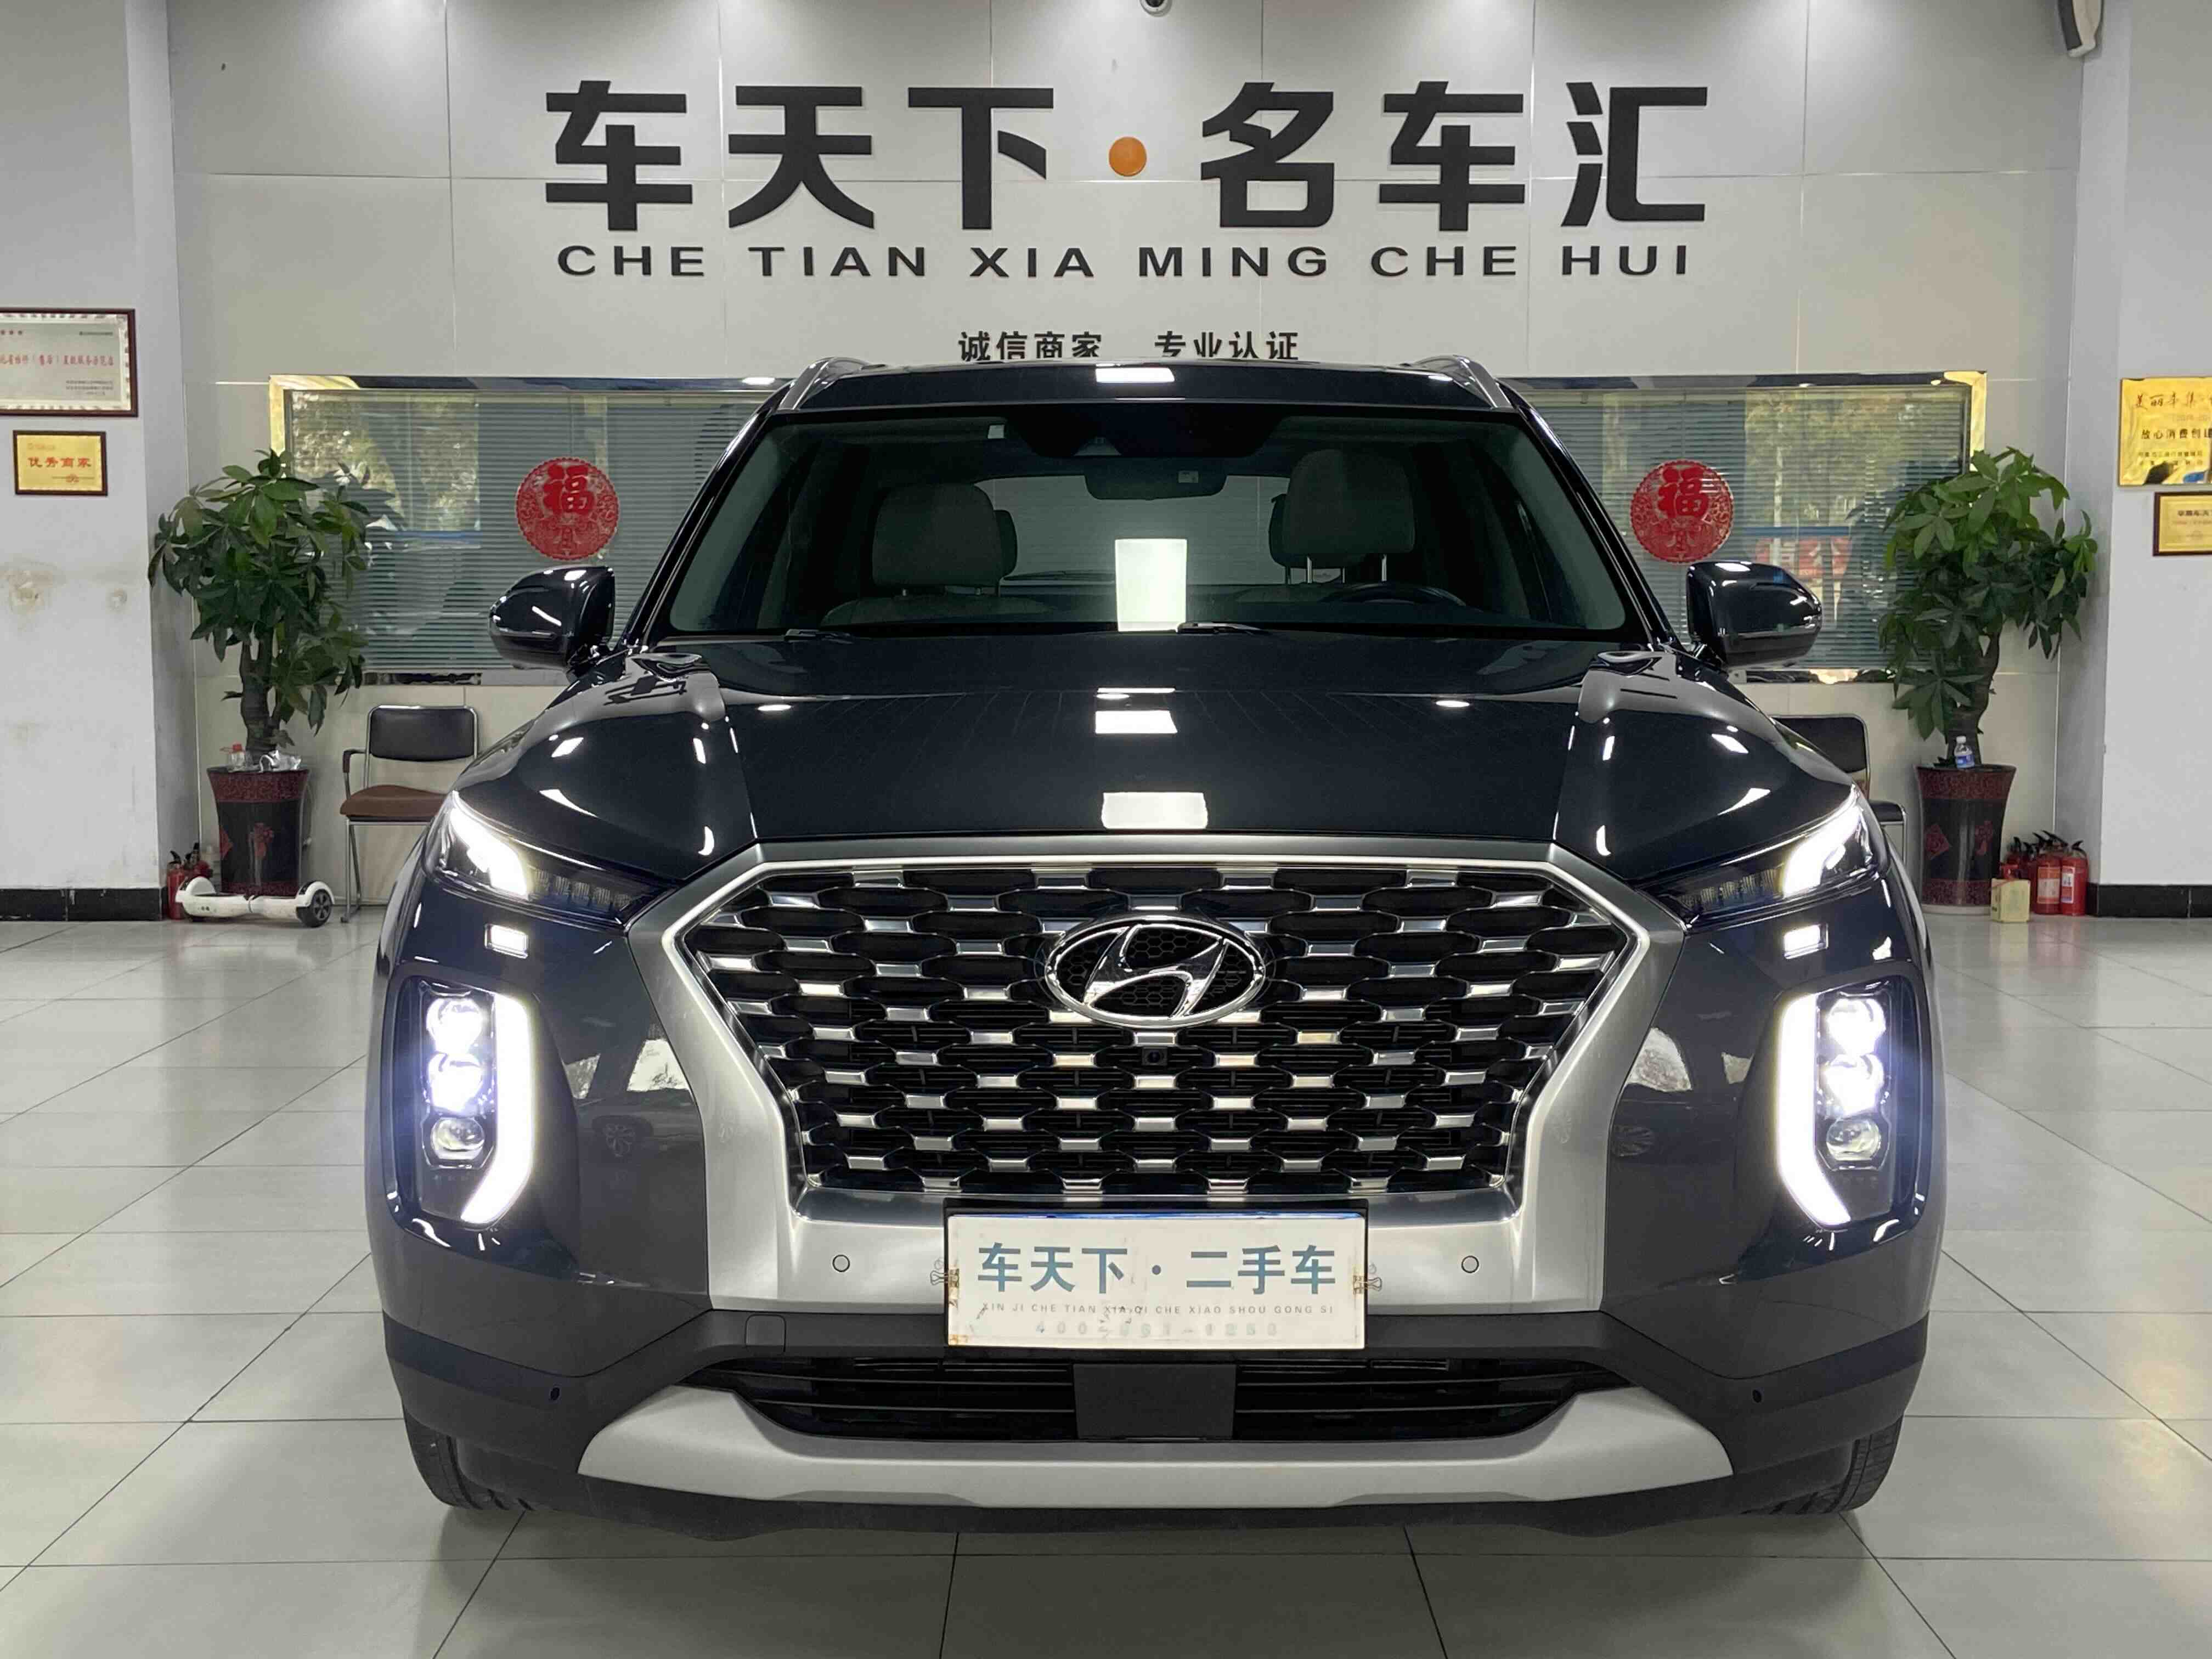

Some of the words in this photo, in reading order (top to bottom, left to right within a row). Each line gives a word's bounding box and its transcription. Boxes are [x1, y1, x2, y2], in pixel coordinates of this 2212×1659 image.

[557, 245, 704, 276] CHE
[748, 246, 925, 276] TIAN
[969, 247, 1094, 278] XIA
[1139, 246, 1327, 277] MING
[1370, 246, 1516, 277] CHE
[1562, 245, 1686, 276] HUI
[958, 331, 1102, 362] 诚信商家
[1154, 331, 1299, 360] 专业认证
[27, 456, 92, 468] 优秀商家
[982, 1303, 1005, 1311] XIN
[1012, 1303, 1024, 1312] JI
[1031, 1304, 1057, 1312] CHE
[1064, 1305, 1096, 1313] TIAN
[1155, 1306, 1181, 1314] CHE
[1189, 1306, 1222, 1314] XIAO
[1228, 1306, 1266, 1314] SHOU
[1274, 1306, 1313, 1314] GONG
[1321, 1306, 1334, 1314] SI
